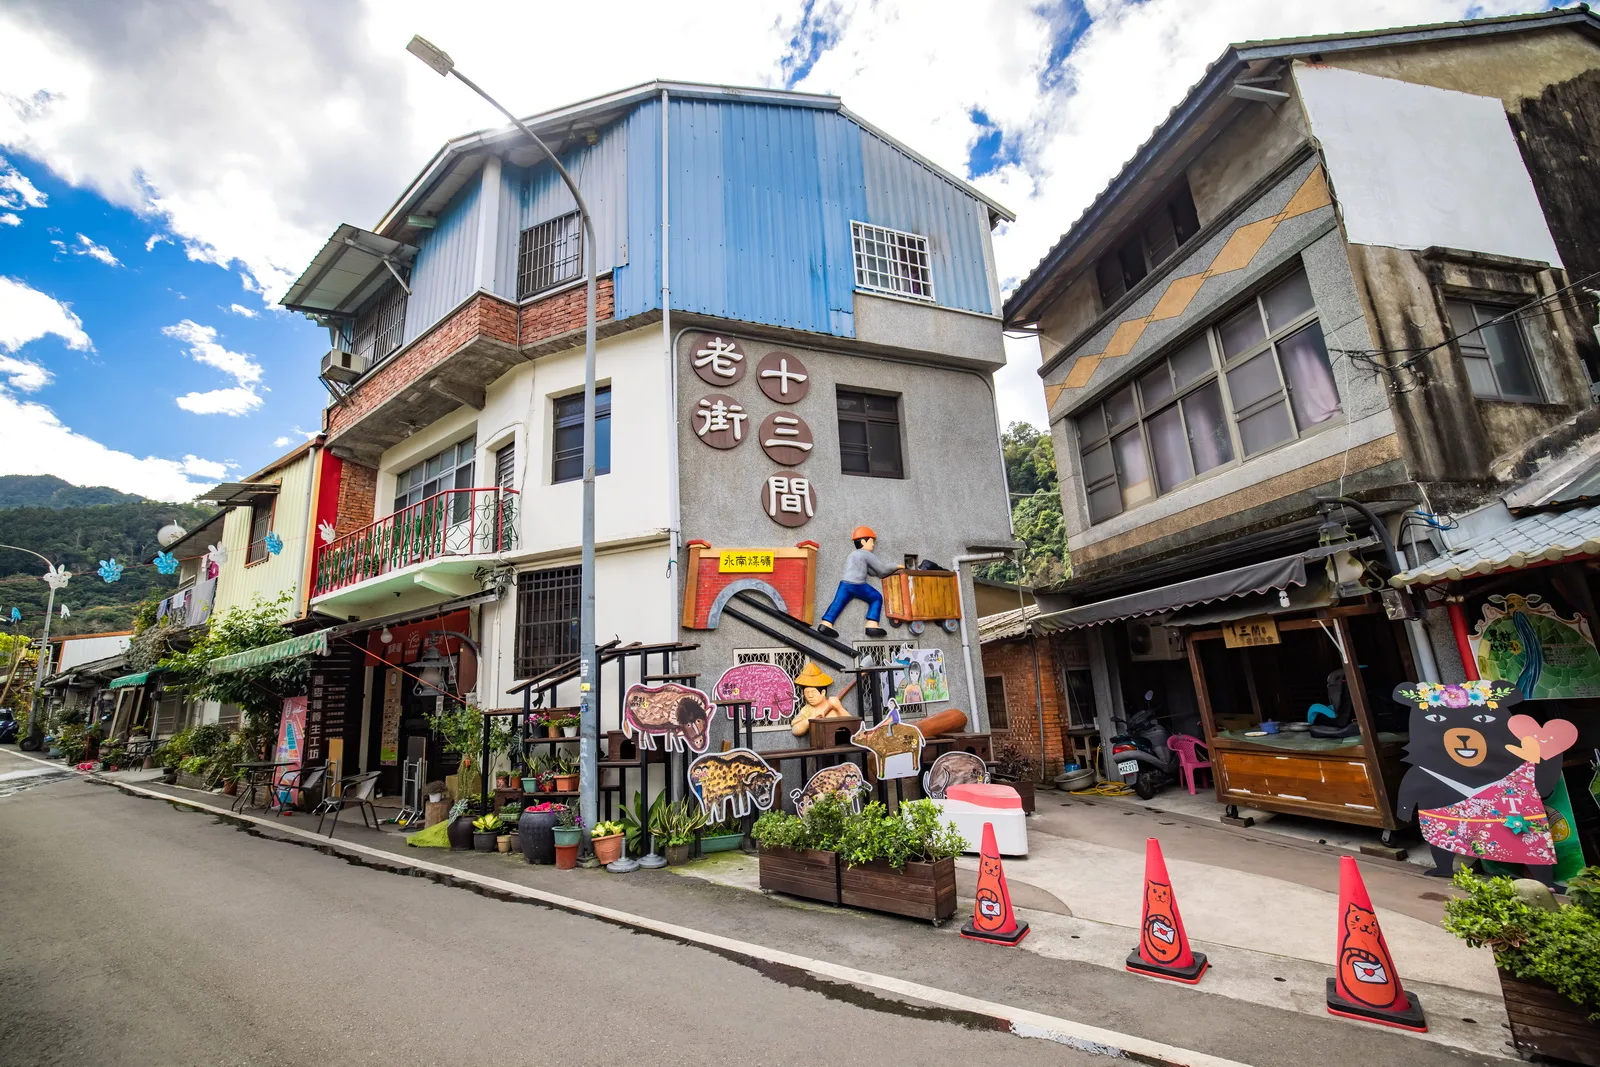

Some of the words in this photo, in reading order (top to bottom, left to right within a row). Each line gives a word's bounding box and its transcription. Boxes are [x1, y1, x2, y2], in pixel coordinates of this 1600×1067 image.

[694, 336, 748, 441] 老街
[760, 358, 814, 518] 十三間
[1502, 797, 1522, 814] T
